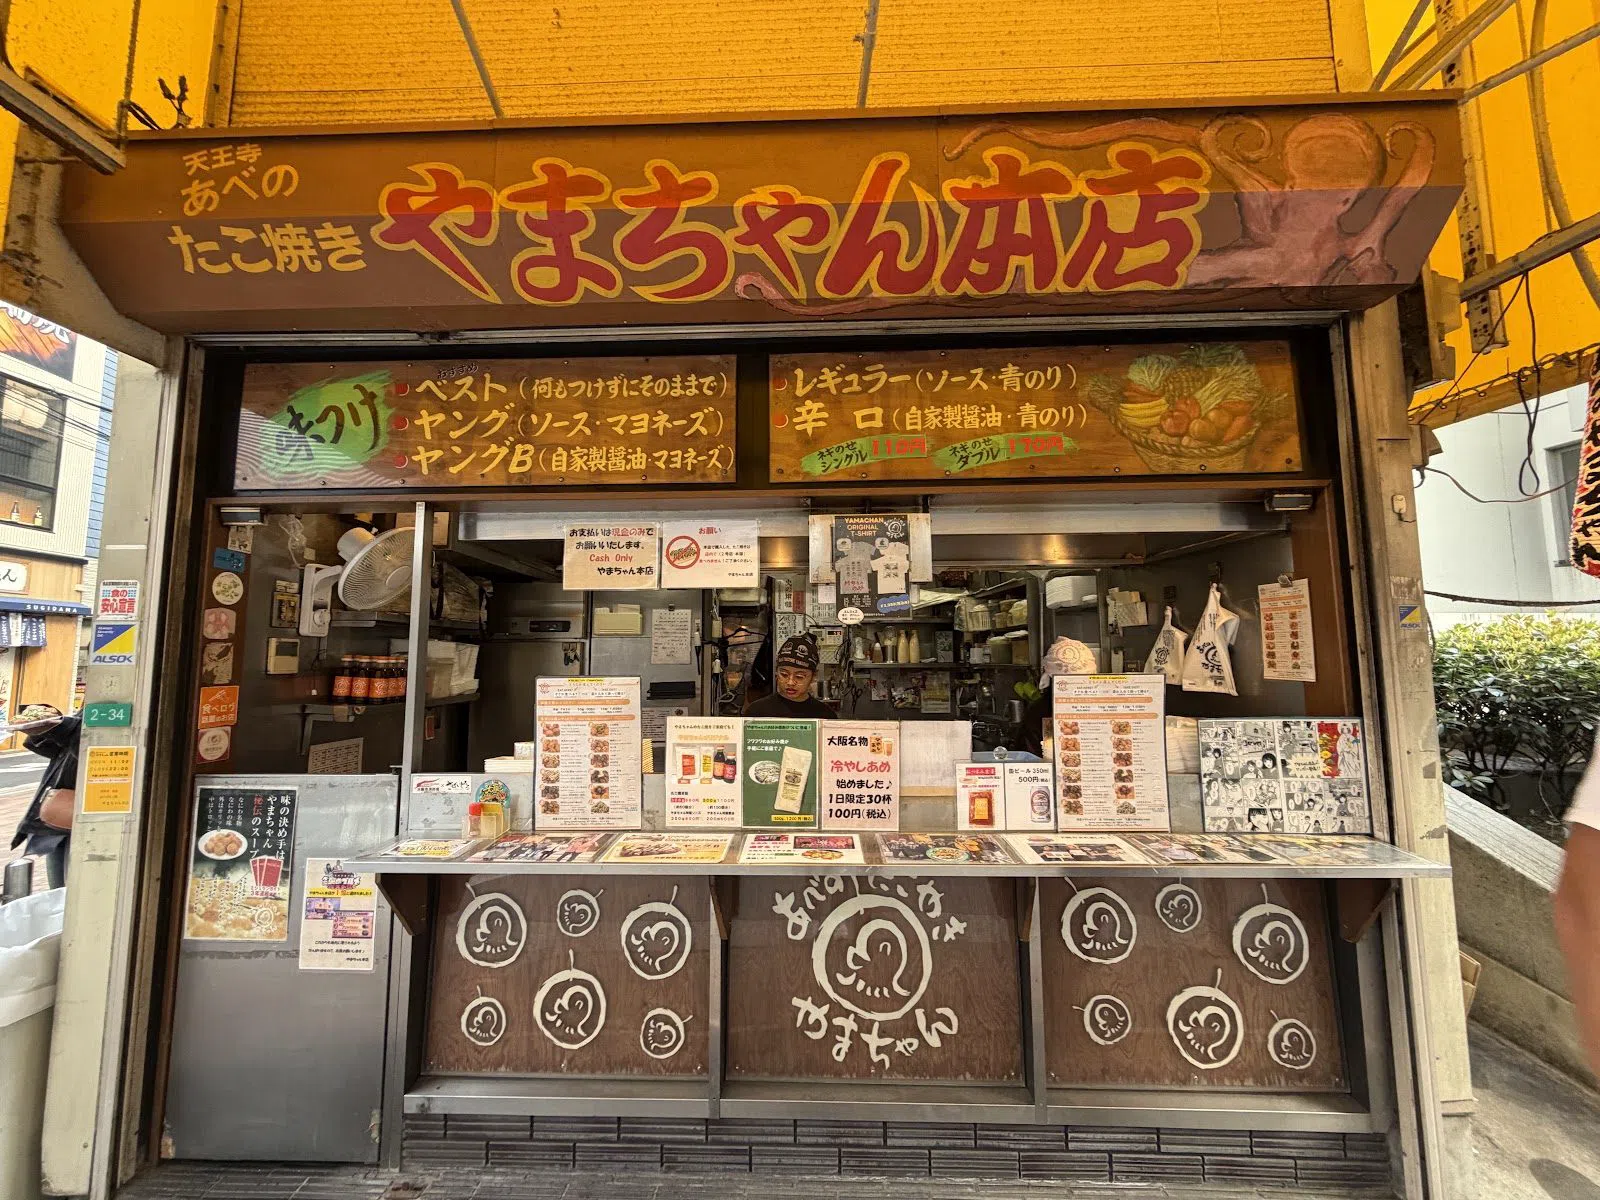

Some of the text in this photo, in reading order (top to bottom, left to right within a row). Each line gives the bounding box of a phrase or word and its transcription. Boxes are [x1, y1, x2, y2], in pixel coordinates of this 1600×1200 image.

[182, 144, 263, 172] 天王寺
[181, 164, 299, 217] あべの
[370, 141, 1211, 306] やまちゃん本店
[167, 222, 367, 276] たこ焼き
[871, 436, 927, 458] 110円
[956, 436, 1065, 470] ダブル 170円
[569, 527, 654, 538] お支払いは現金のみで
[575, 540, 645, 550] お願いいたします。
[589, 553, 634, 563] Cash Only
[0, 568, 18, 583] ん
[596, 566, 654, 576] やまちゃん本店
[111, 588, 128, 598] 食の
[25, 604, 78, 613] SUGIDAMA
[100, 598, 136, 613] 安心宣言
[92, 653, 133, 665] ALSOK
[90, 708, 125, 722] 2-34
[202, 703, 236, 714] 食べログ
[827, 735, 869, 747] 大阪名物
[830, 760, 892, 774] 冷やしあめ
[828, 793, 893, 805] 1日限定30杯
[249, 794, 264, 859] 秘伝のスープ
[262, 794, 278, 849] やまちゃん
[276, 794, 291, 860] 味の決め手は
[791, 996, 959, 1070] やまちゃん
